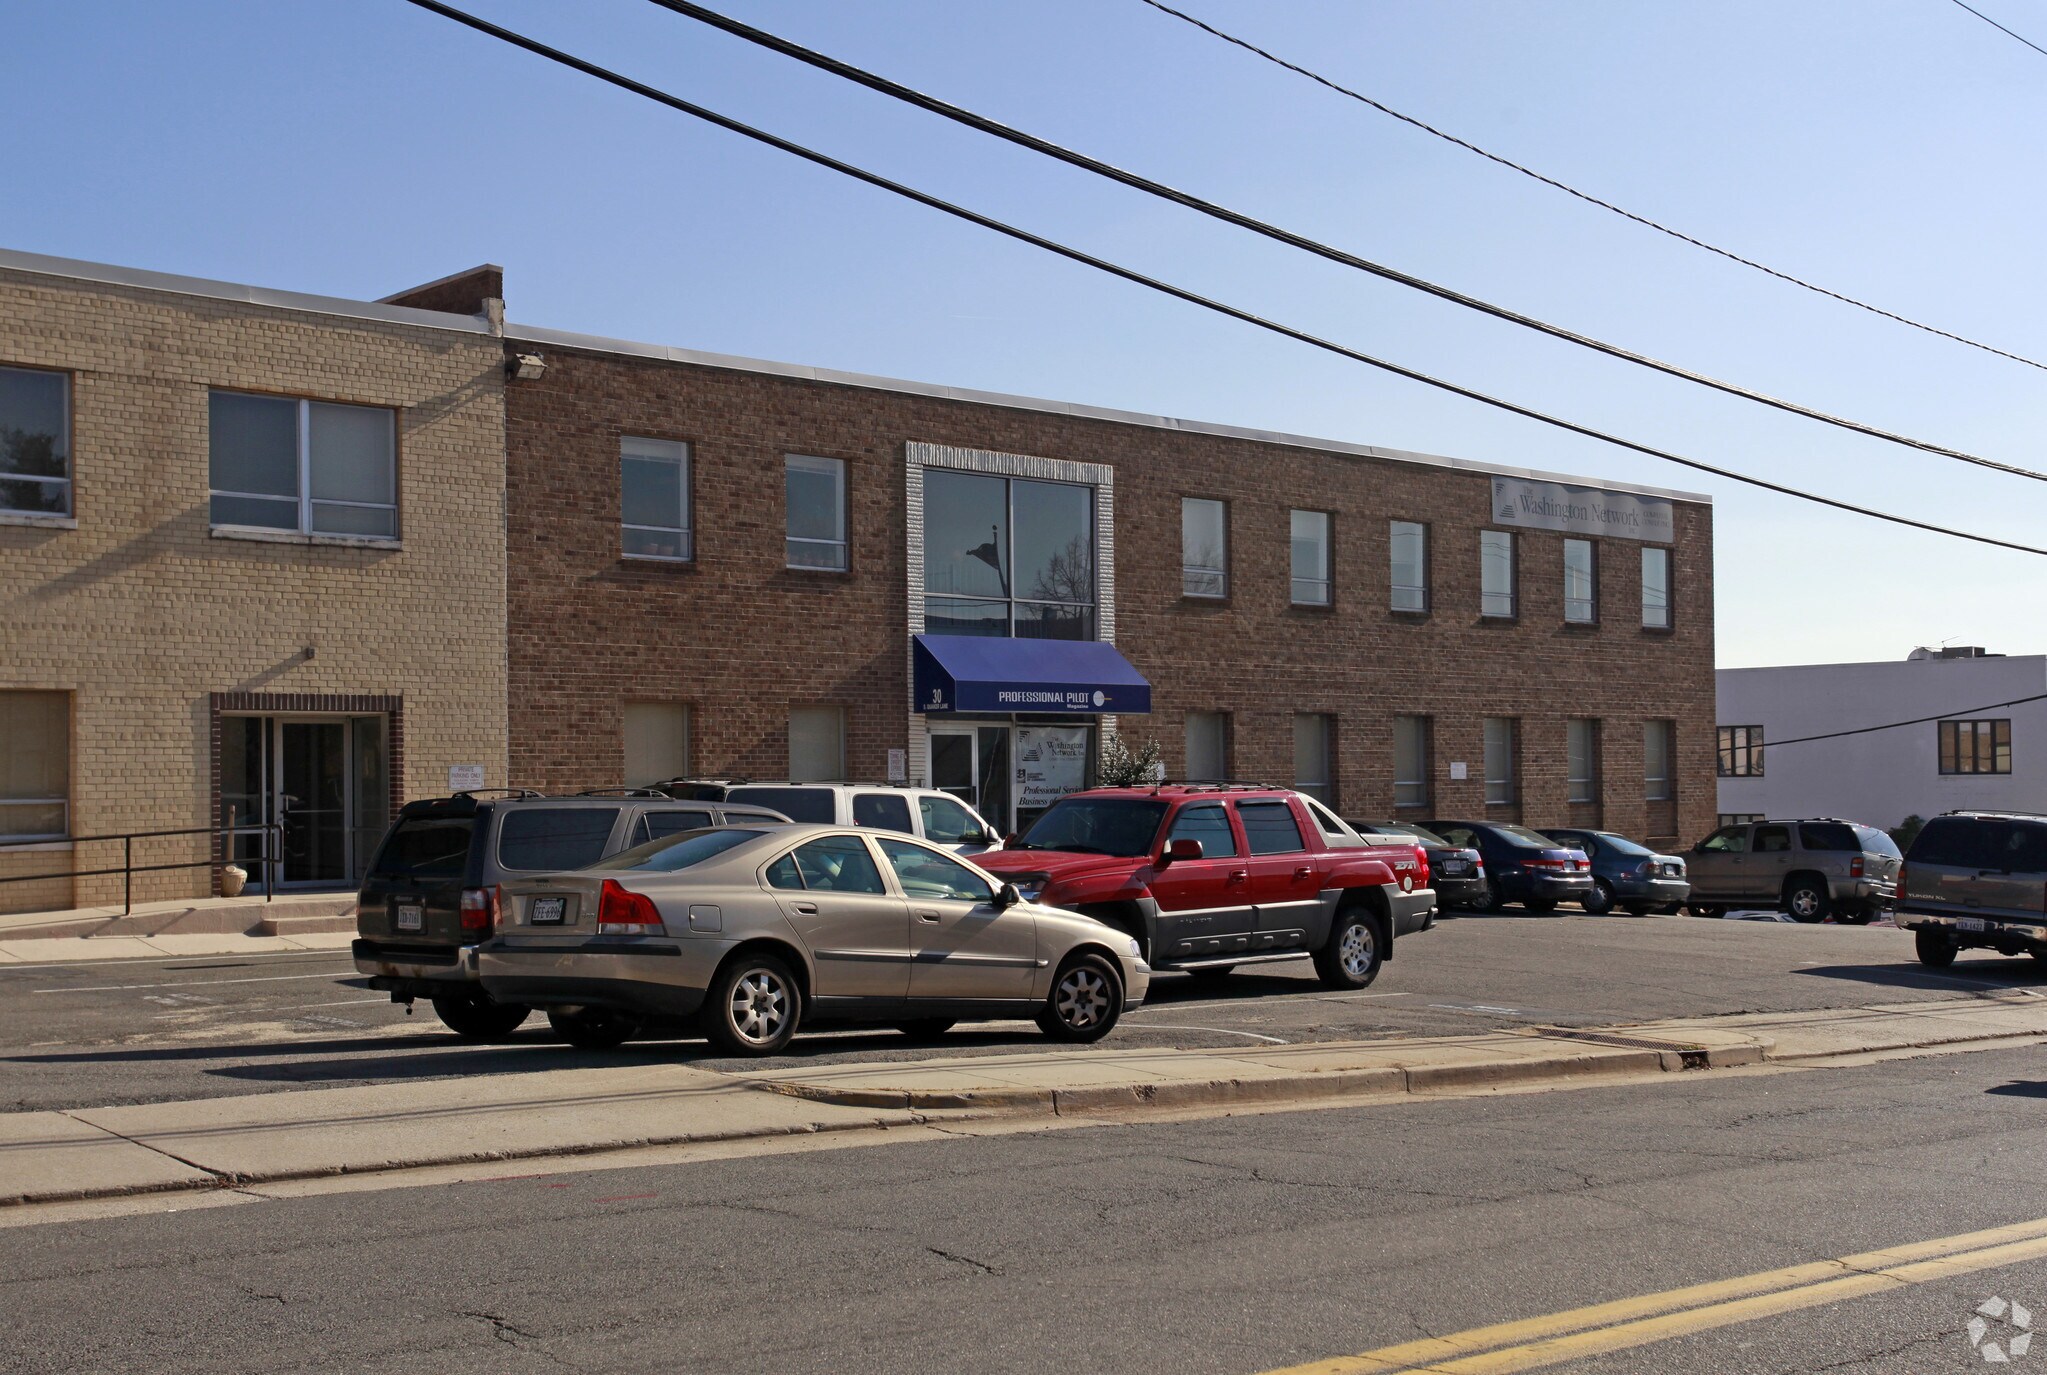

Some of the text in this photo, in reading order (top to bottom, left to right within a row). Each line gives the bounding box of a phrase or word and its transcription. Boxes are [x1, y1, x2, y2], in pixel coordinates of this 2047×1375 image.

[1520, 494, 1640, 527] Washington Network
[932, 688, 942, 703] 30
[998, 691, 1090, 703] PROFESSIONAL PILOT
[1023, 785, 1061, 795] Professional
[1018, 796, 1048, 806] Business
[1394, 860, 1417, 871] Z71
